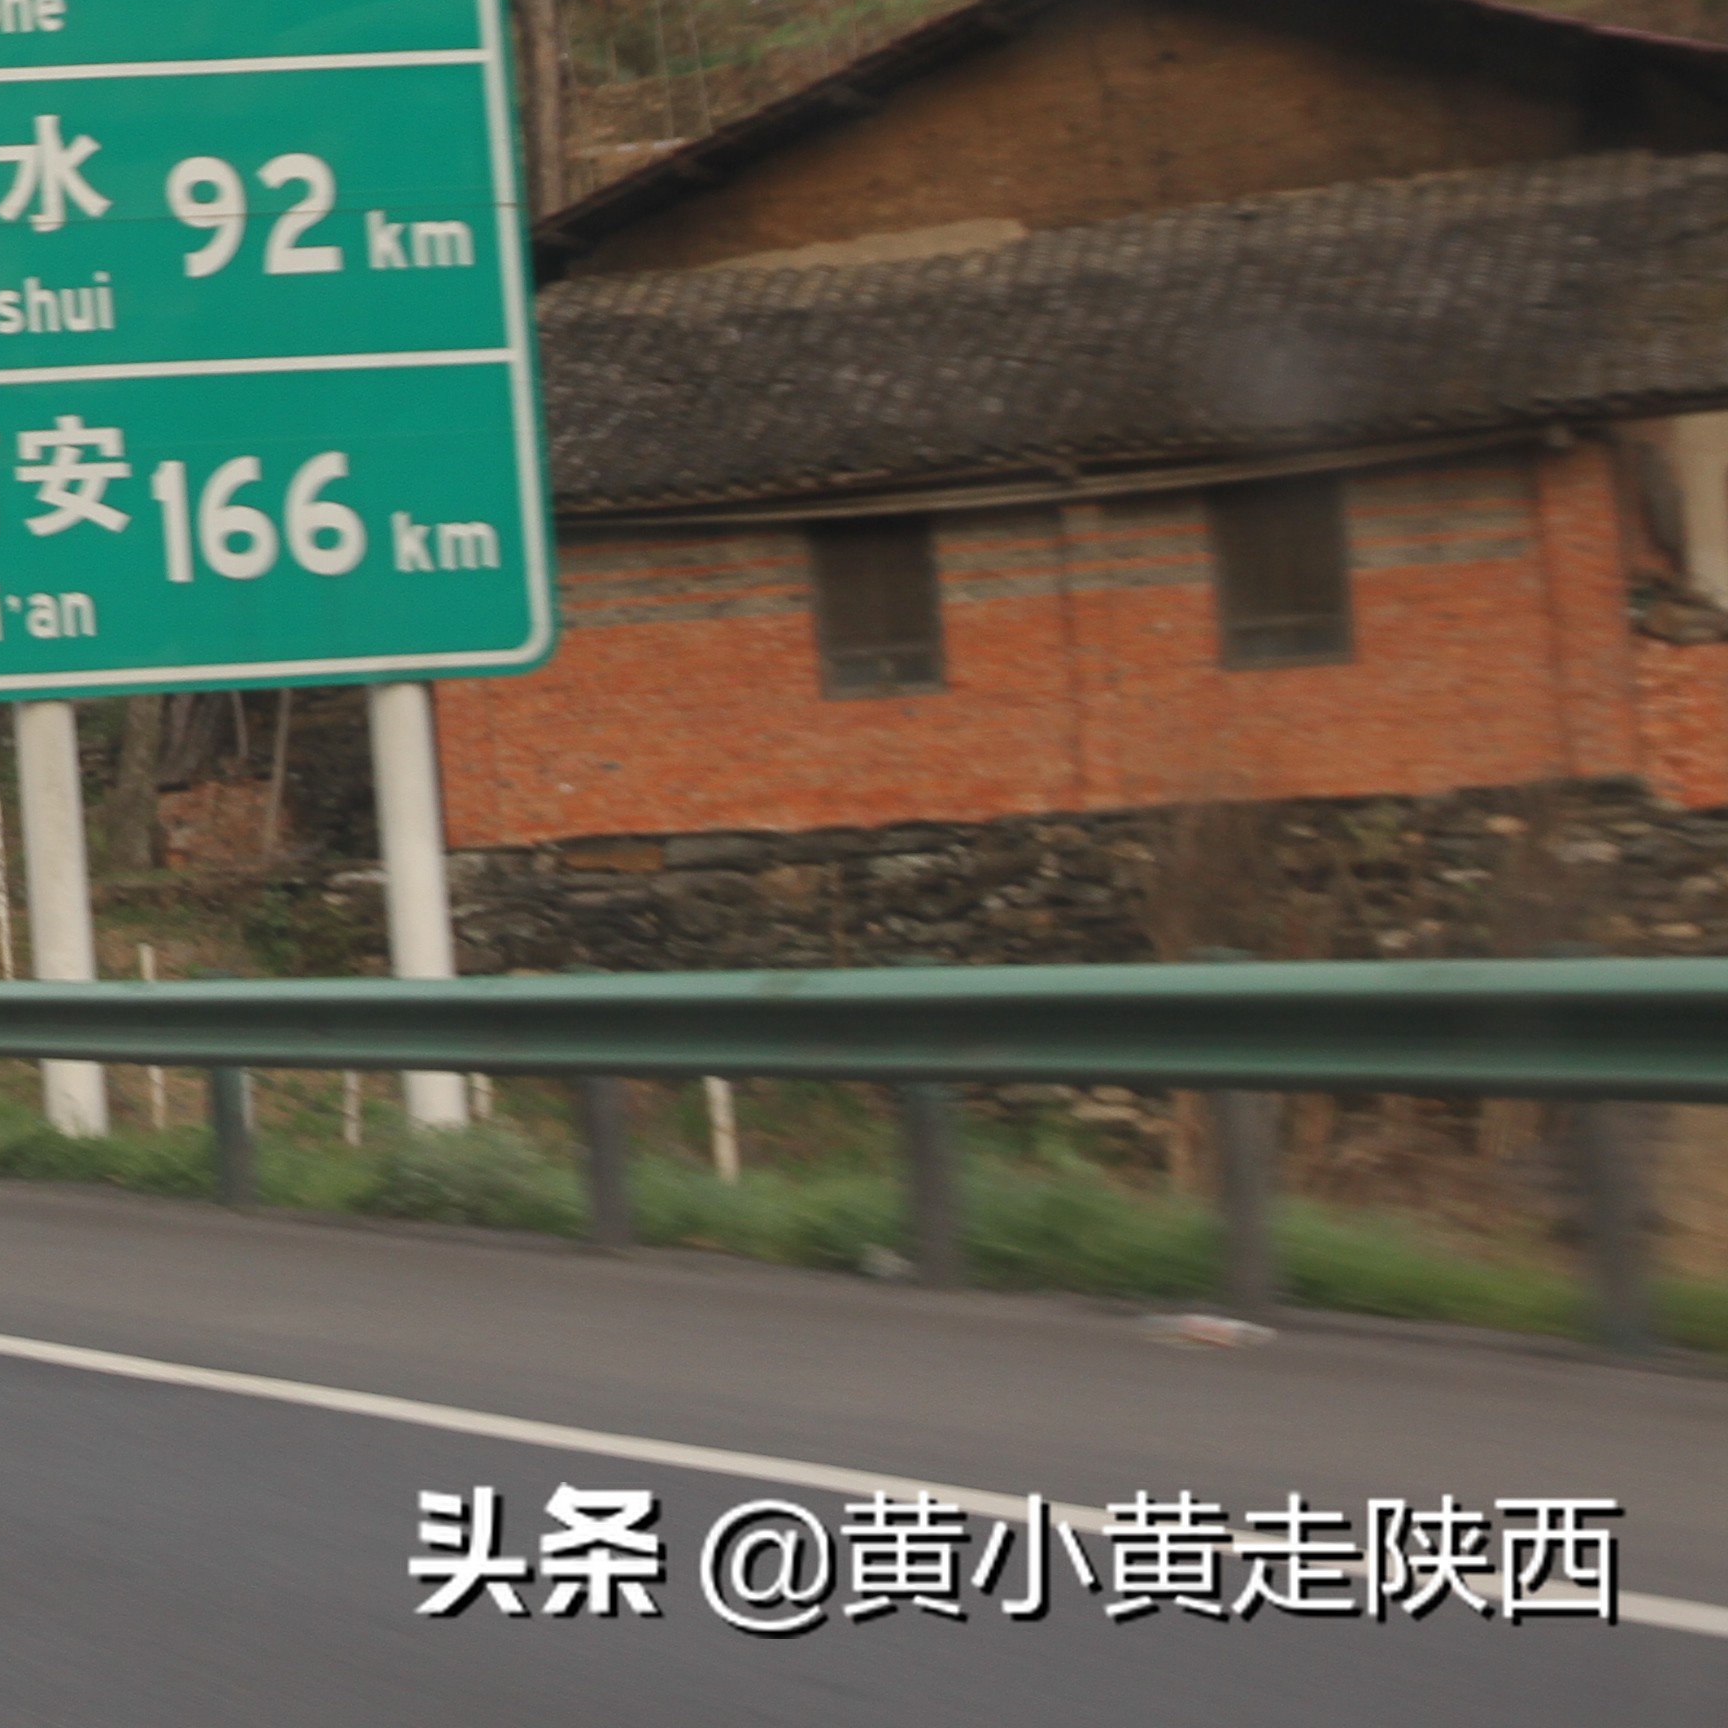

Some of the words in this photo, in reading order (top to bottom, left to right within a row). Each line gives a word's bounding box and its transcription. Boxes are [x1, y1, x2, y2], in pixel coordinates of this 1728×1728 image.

[165, 153, 343, 279] 92
[364, 209, 475, 271] km
[150, 451, 368, 584] 166
[390, 511, 501, 574] km
